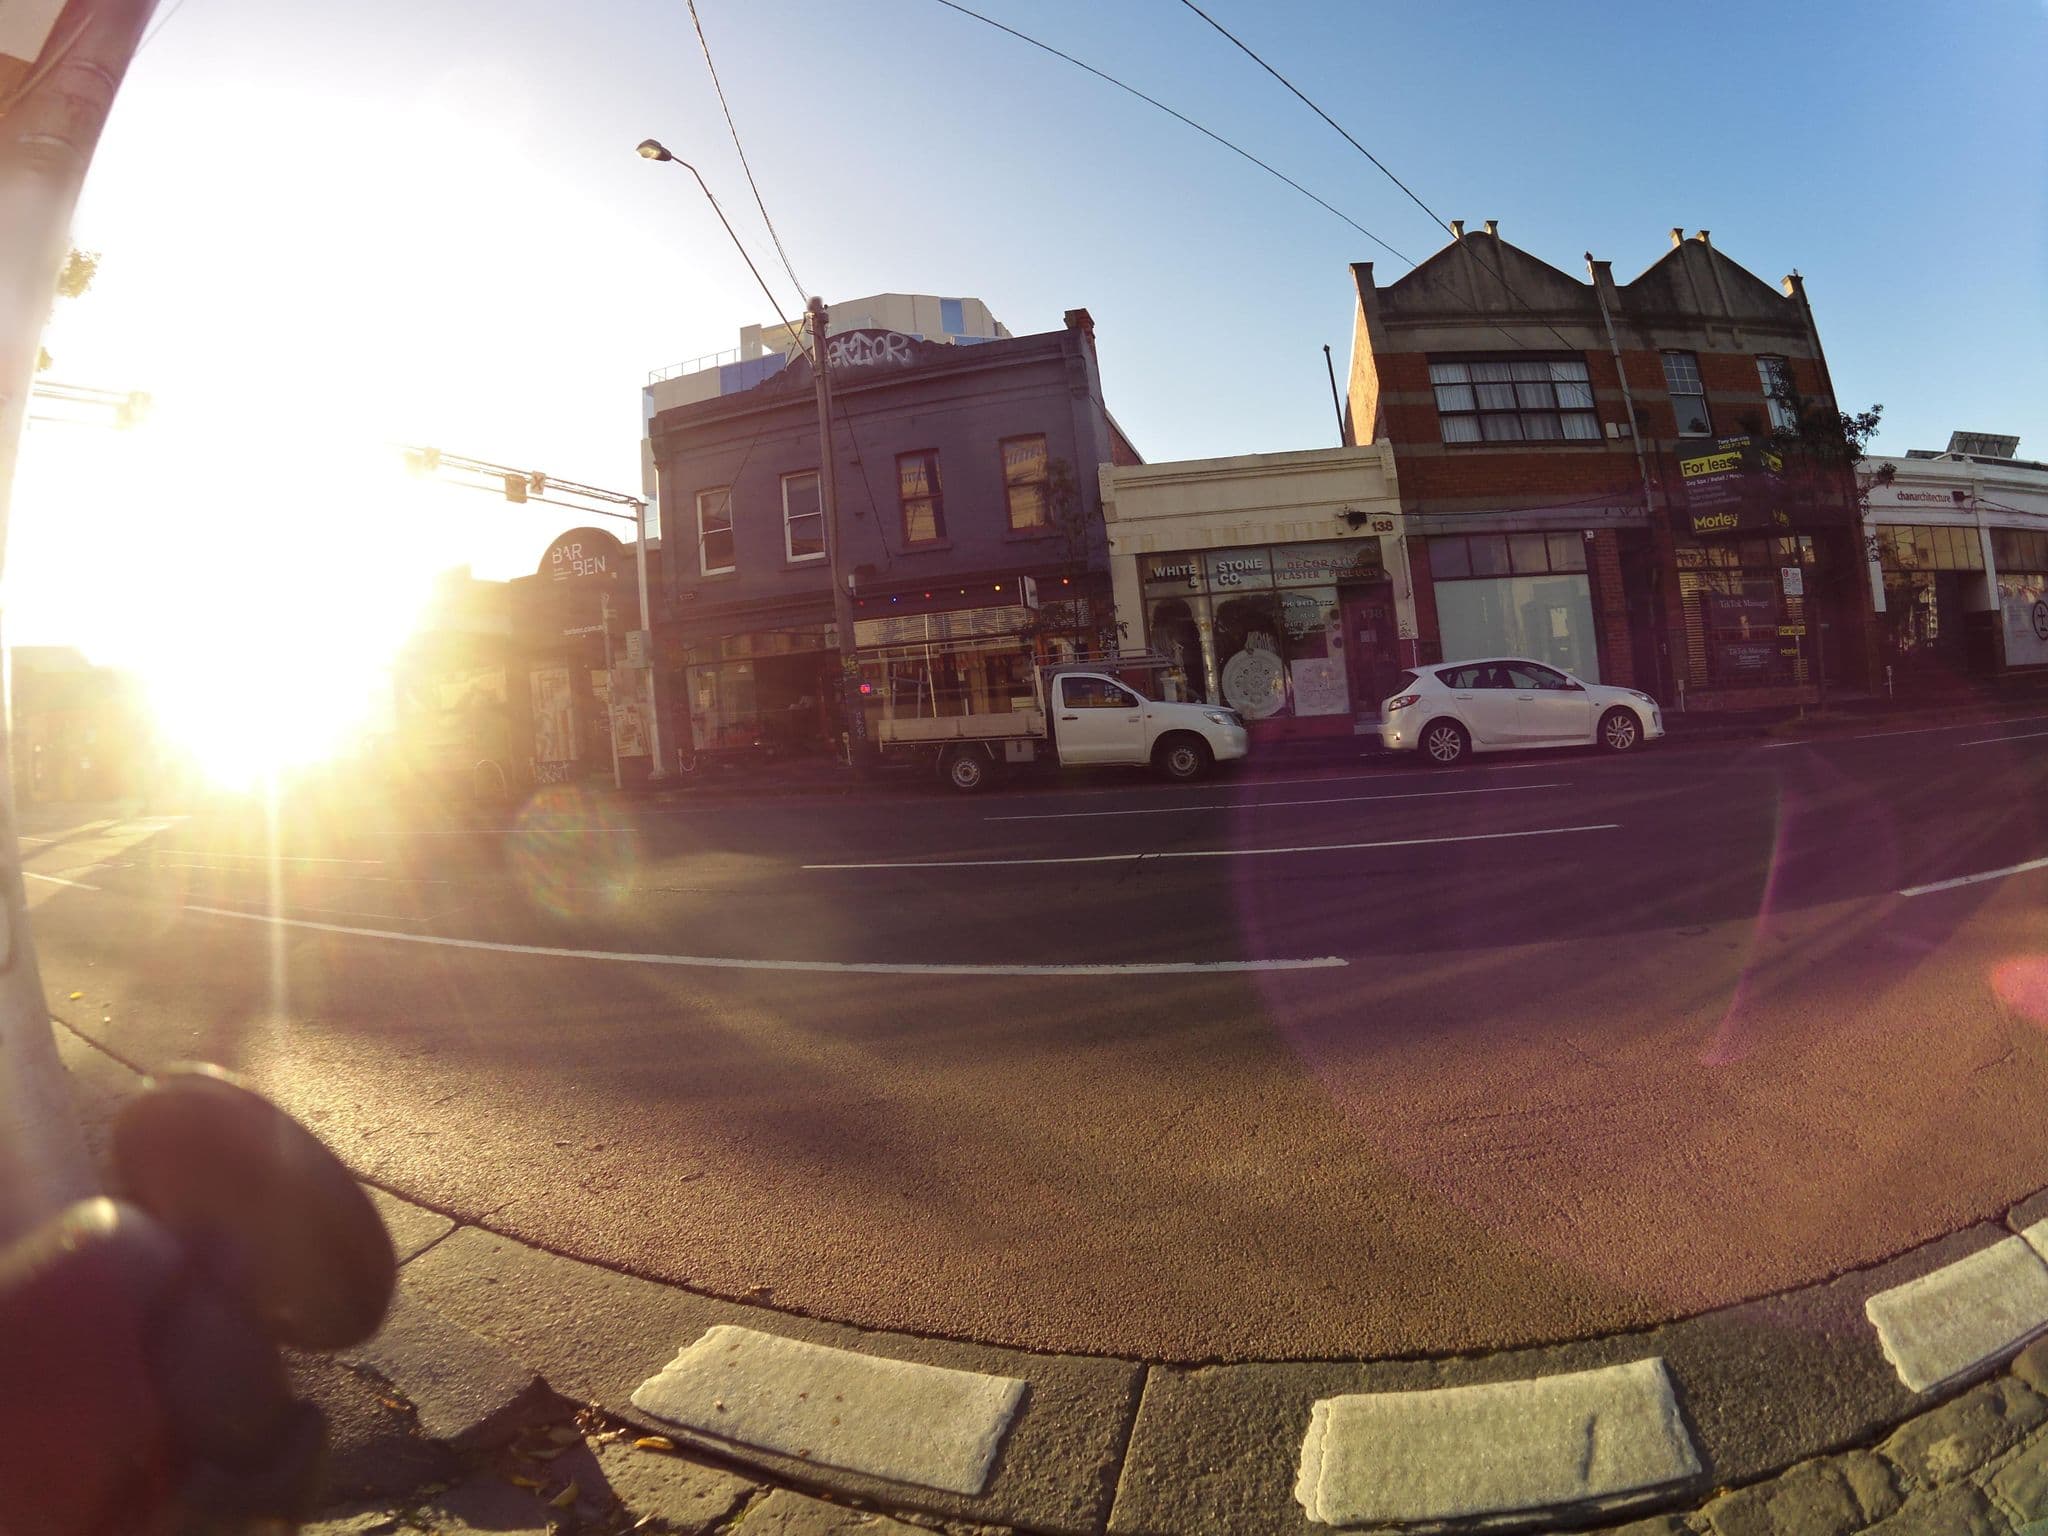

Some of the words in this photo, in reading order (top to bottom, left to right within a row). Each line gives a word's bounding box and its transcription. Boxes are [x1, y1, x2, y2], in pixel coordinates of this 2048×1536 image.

[1683, 461, 1706, 475] For
[1707, 456, 1737, 471] leas
[1897, 491, 1951, 502] chanarchitecture
[1372, 520, 1394, 532] 138
[1693, 513, 1739, 530] Morley
[552, 543, 583, 564] BAR
[573, 555, 606, 576] BEN
[1153, 564, 1198, 577] WHITE
[1218, 559, 1263, 572] STONE
[1189, 576, 1199, 587] &
[1219, 573, 1241, 584] CO.
[1275, 570, 1320, 580] PLASTER
